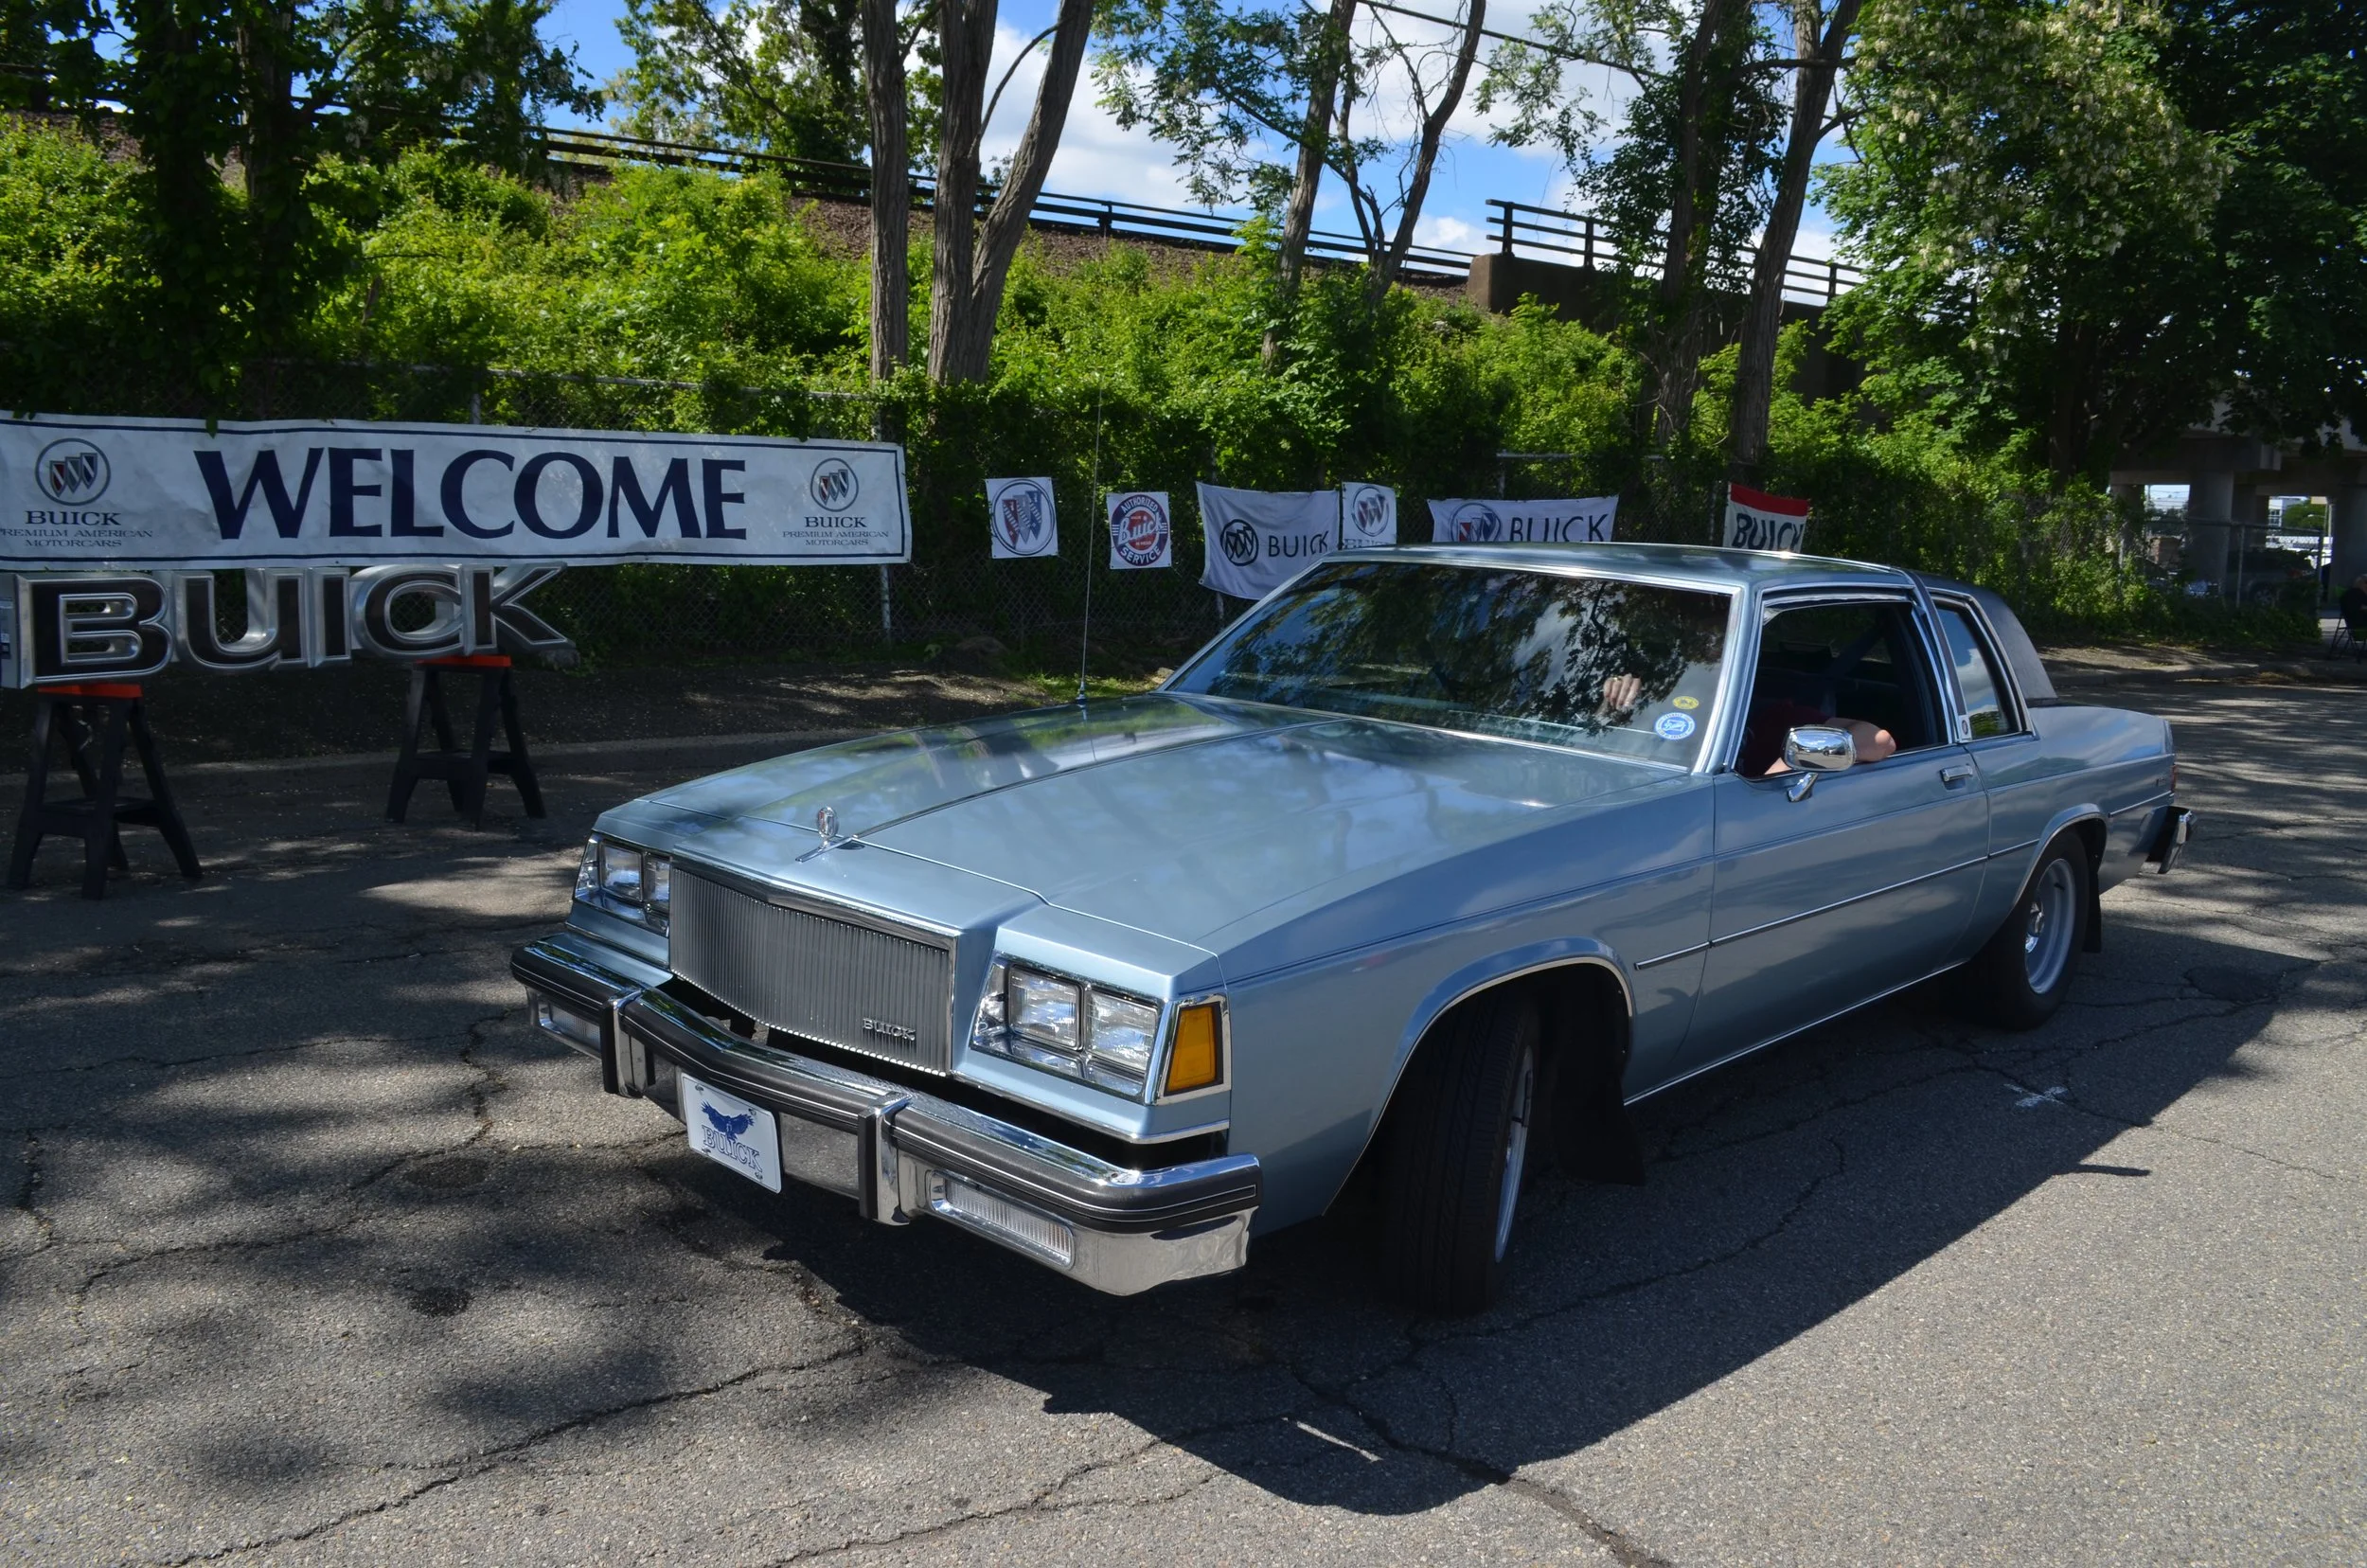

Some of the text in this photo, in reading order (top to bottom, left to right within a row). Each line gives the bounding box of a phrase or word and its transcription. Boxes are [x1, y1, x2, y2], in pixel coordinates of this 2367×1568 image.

[193, 447, 747, 540] WELCOME
[1120, 496, 1159, 513] AUTHORIZED
[25, 510, 122, 526] BUICK
[804, 516, 868, 528] BUICK
[1509, 513, 1610, 543] BUICK
[74, 528, 153, 538] AMERICAN
[782, 530, 889, 539] PREMIUM AMERICAN
[1117, 511, 1164, 547] Buick
[25, 539, 122, 548] MOTORCARS
[1268, 530, 1330, 558] BUICK
[1120, 545, 1162, 564] SERVICE
[11, 561, 575, 689] BUICK
[863, 1018, 917, 1042] BUICK
[702, 1124, 764, 1173] BUICK
